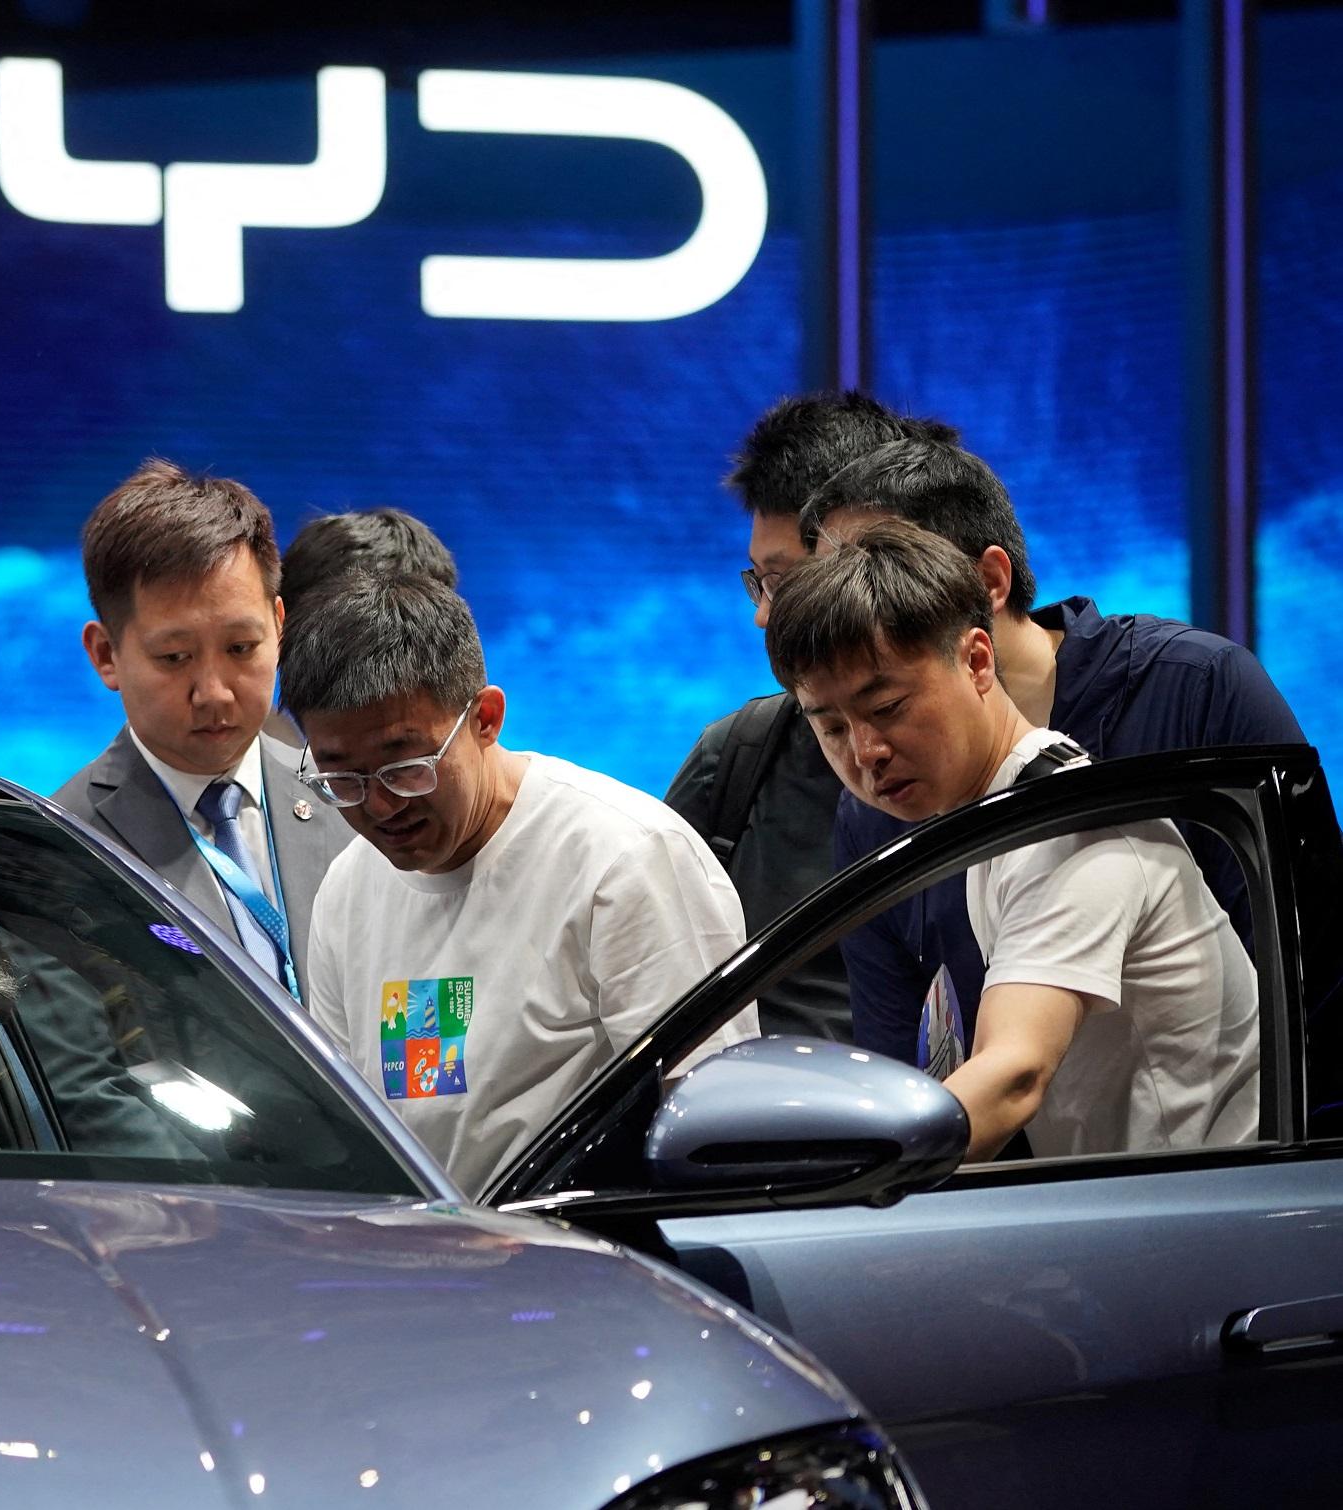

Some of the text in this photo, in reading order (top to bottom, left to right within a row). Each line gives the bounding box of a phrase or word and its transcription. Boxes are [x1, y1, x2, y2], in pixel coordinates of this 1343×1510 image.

[455, 981, 464, 1020] ISLAND
[463, 980, 472, 1027] SUMMER
[383, 1060, 405, 1072] PEPCO
